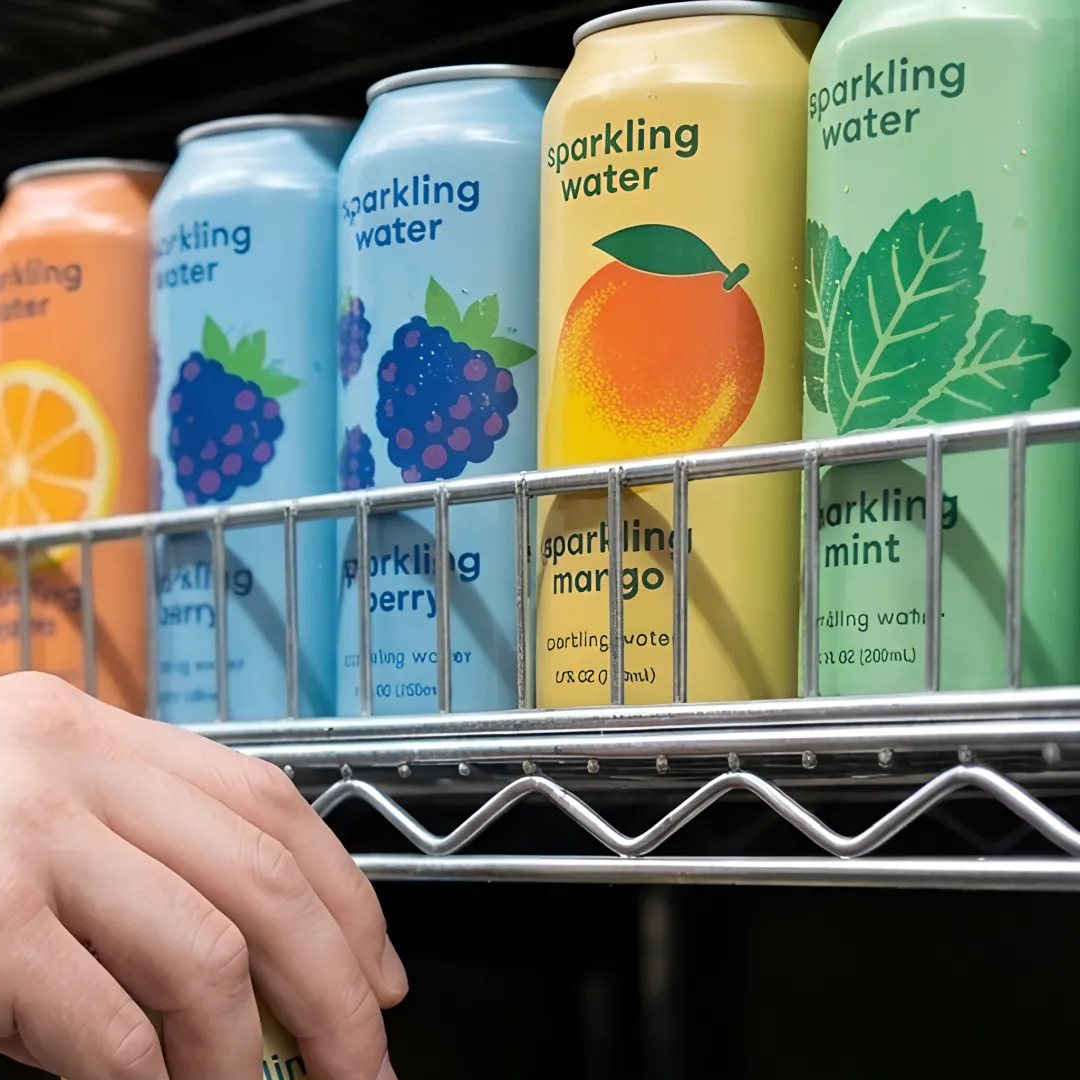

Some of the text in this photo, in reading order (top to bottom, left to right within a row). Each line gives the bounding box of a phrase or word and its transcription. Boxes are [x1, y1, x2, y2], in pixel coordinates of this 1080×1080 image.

[809, 56, 967, 119] sparkling
[547, 117, 700, 174] sparkling
[822, 107, 920, 151] water
[341, 173, 480, 226] sparkling
[561, 163, 658, 202] water
[355, 216, 443, 251] water
[819, 487, 959, 530] arkling
[824, 532, 900, 568] mint
